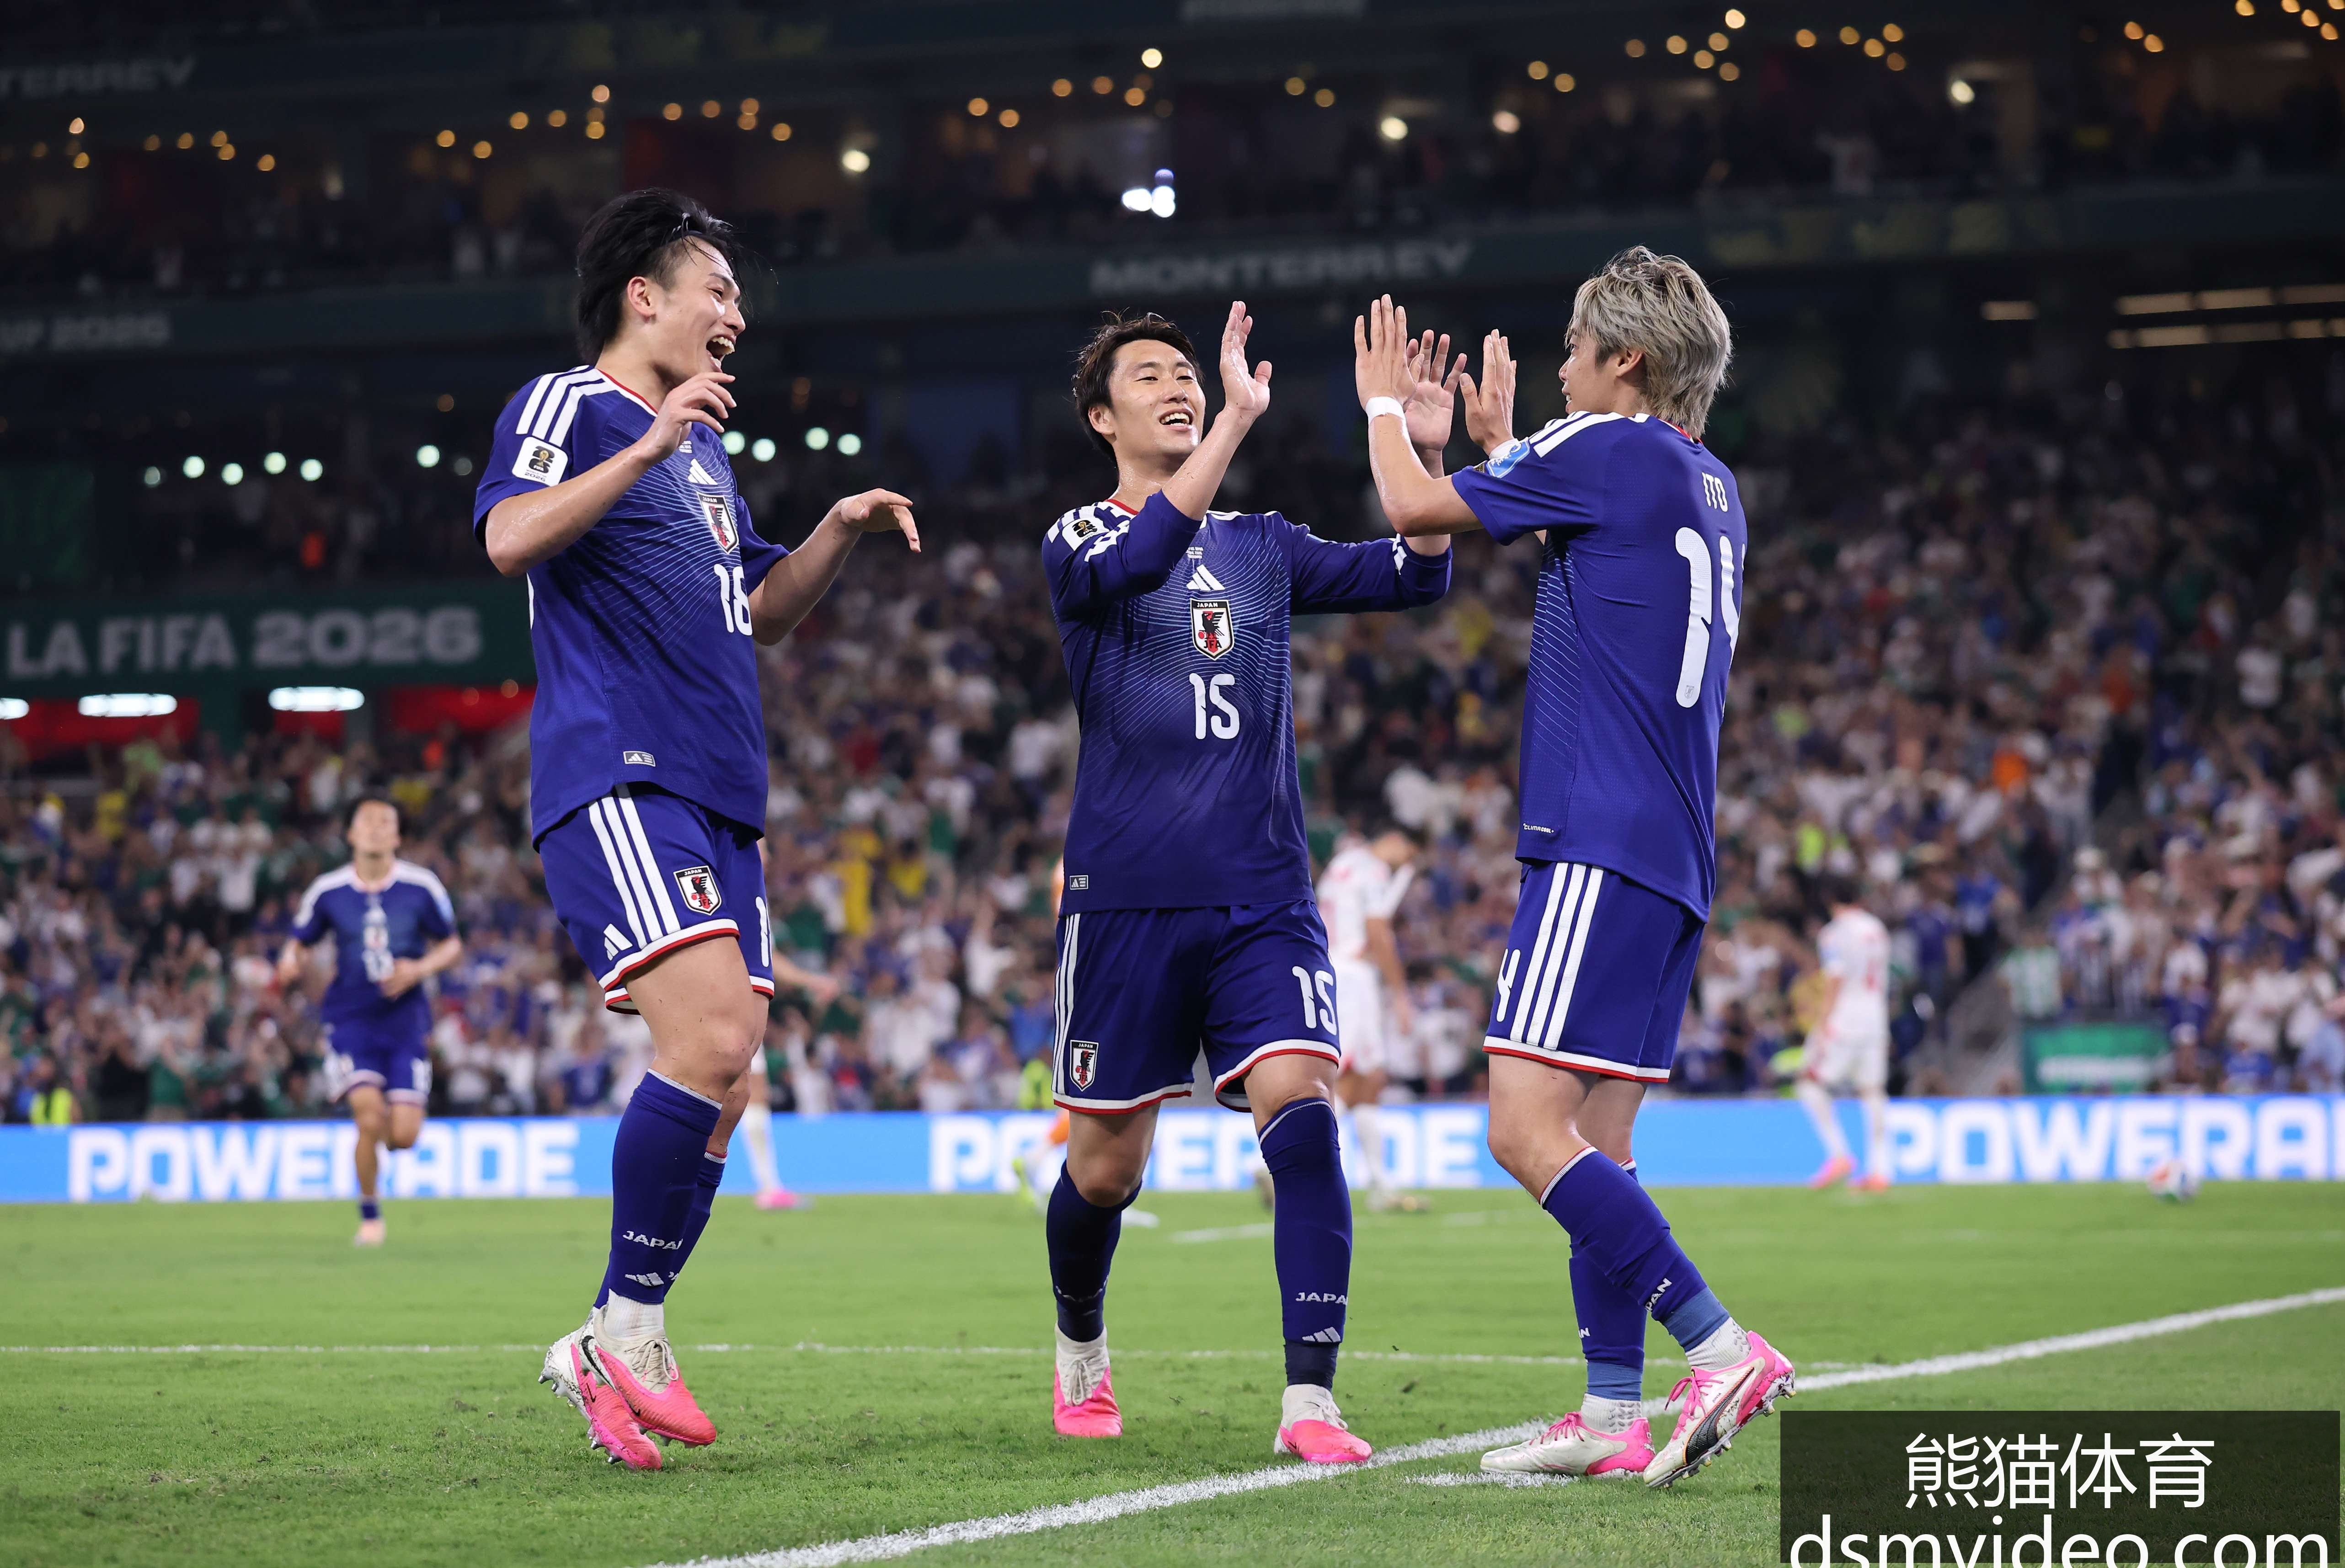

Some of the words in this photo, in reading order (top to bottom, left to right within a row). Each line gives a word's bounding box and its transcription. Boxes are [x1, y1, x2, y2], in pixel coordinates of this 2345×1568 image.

[1090, 242, 1470, 295] MONTERREY
[1701, 471, 1728, 512] ITO
[713, 564, 753, 635] 18
[7, 624, 88, 678] LA
[100, 613, 237, 674] FIFA
[250, 606, 483, 668] 2026
[1189, 672, 1240, 740] 15
[755, 896, 772, 968] 1
[1292, 965, 1338, 1035] 15
[1885, 1098, 2345, 1184] POWERA
[1295, 1292, 1348, 1307] JAPA
